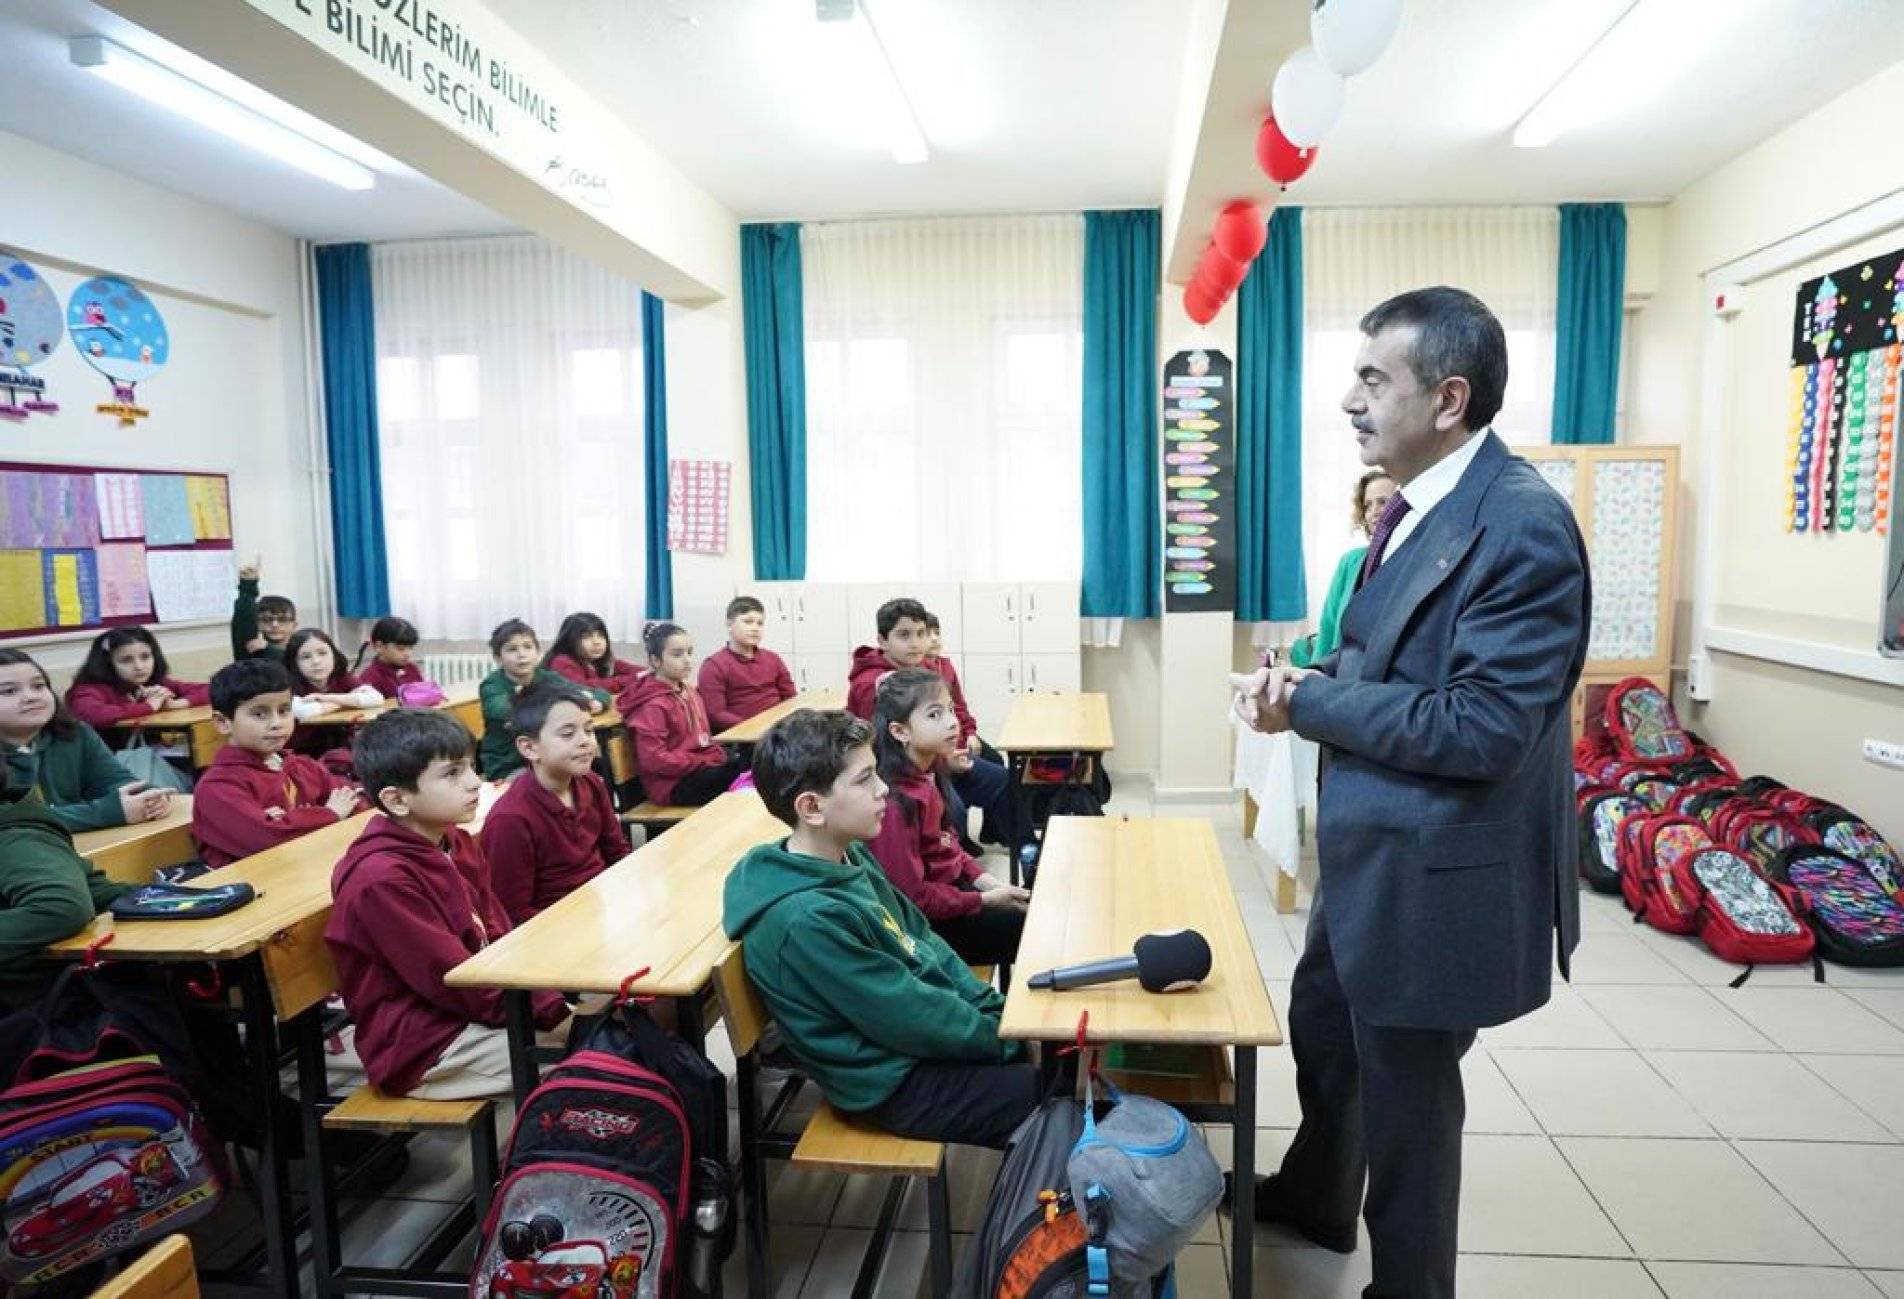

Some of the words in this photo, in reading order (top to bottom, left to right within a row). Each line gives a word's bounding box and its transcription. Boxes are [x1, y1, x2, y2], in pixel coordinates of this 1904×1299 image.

[327, 0, 412, 81] BİLİMİ
[423, 62, 500, 137] SEÇİN.
[374, 0, 482, 78] ZLERİM
[491, 59, 558, 132] BİLİMLE
